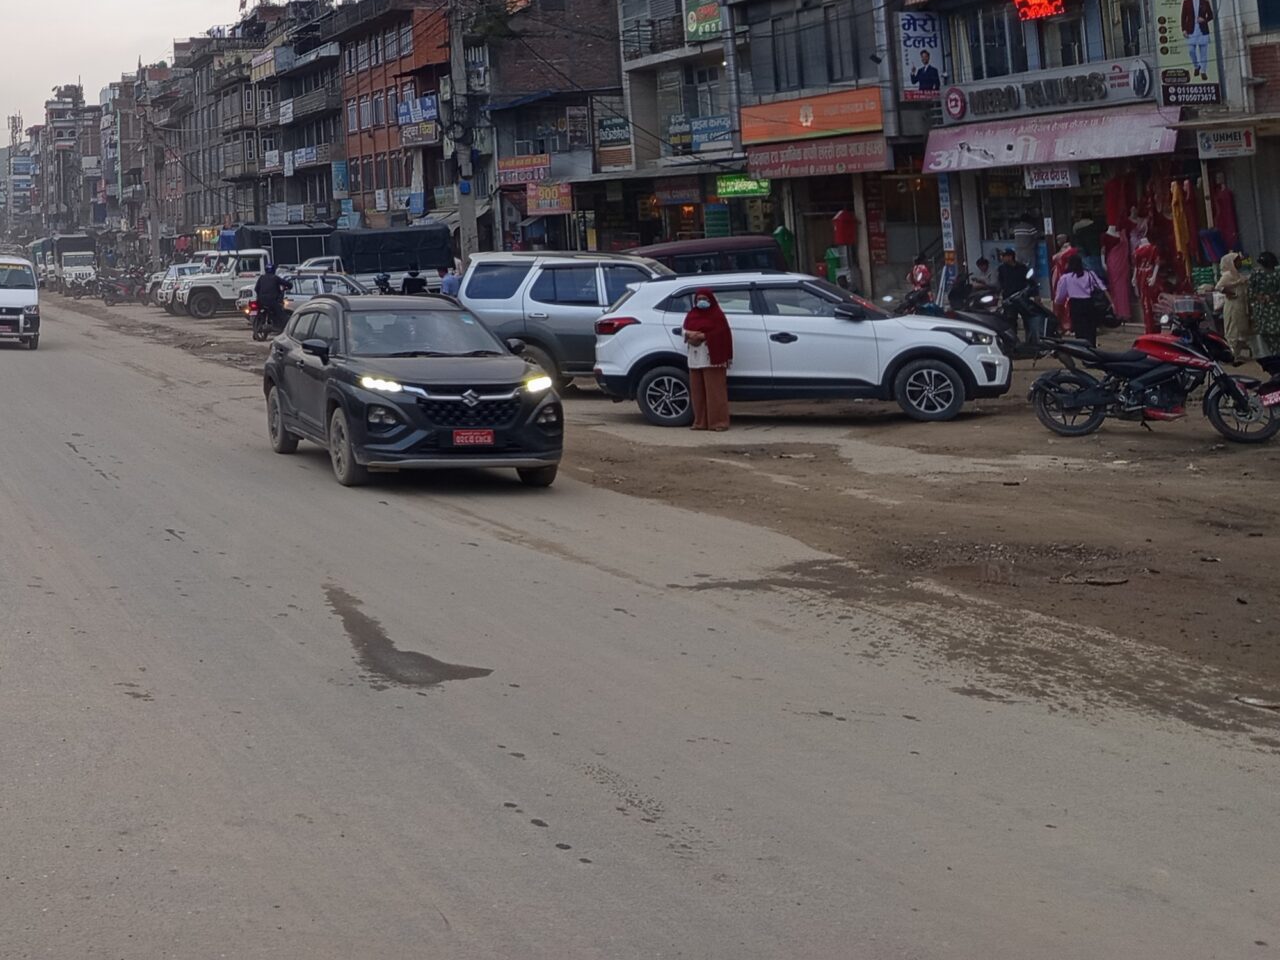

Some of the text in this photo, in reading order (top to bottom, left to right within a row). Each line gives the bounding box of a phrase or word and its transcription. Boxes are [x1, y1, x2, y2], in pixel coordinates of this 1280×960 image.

[901, 13, 937, 33] मेरो
[902, 32, 938, 49] टेलर्स
[1212, 131, 1242, 143] UNMEI
[538, 188, 558, 200] 900
